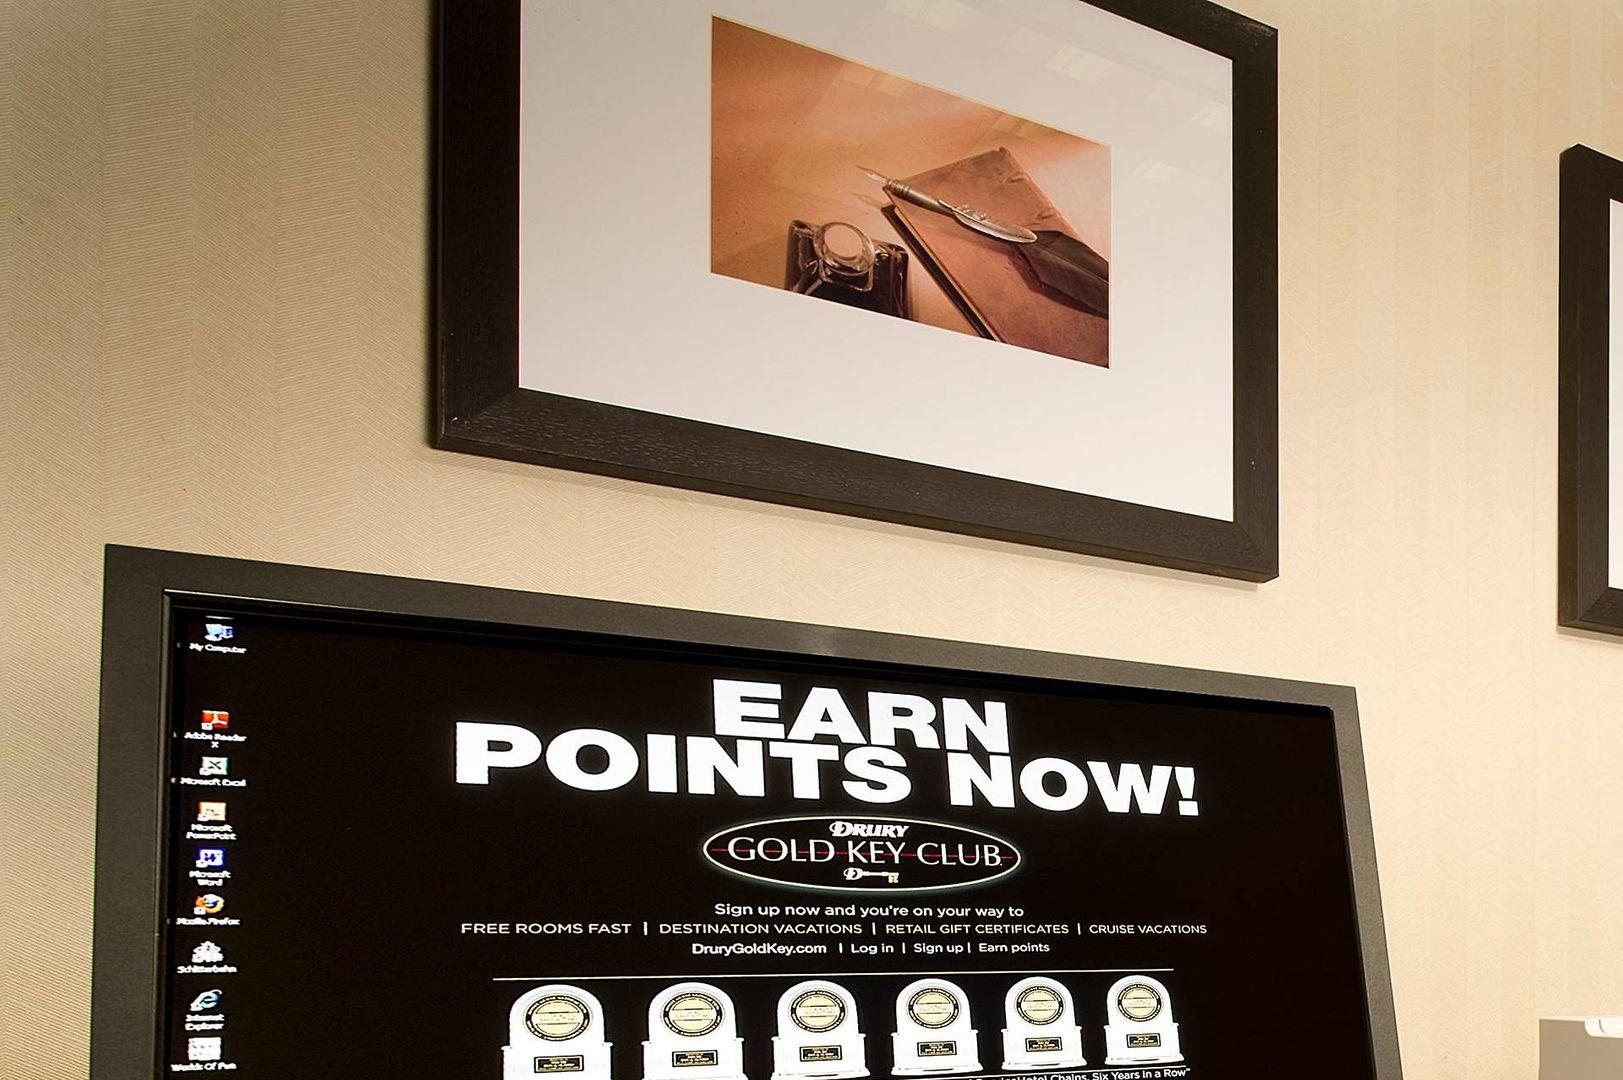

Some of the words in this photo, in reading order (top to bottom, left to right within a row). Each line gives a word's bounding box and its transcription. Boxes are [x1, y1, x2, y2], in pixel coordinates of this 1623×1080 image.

[712, 678, 1010, 755] EARN
[455, 721, 912, 804] POINTS
[946, 752, 1200, 817] NOW!
[727, 836, 835, 863] GOLD
[847, 840, 906, 864] KEY
[916, 842, 1002, 867] CLUB
[715, 903, 753, 918] Sign
[758, 906, 780, 917] up
[785, 906, 820, 916] now
[825, 904, 855, 916] and
[860, 905, 908, 918] you're
[913, 907, 932, 917] on
[937, 907, 971, 918] your
[975, 907, 1004, 918] way
[1008, 906, 1024, 916] to
[461, 923, 510, 934] FREE
[516, 923, 583, 935] ROOMS
[589, 923, 631, 934] FAST
[660, 923, 769, 934] DESTINATION
[774, 923, 862, 934] VACATIONS
[886, 924, 936, 934] RETAIL
[940, 924, 970, 934] GIFT
[975, 924, 1069, 934] CERTIFICATES
[1089, 924, 1134, 934] CRUISE
[1138, 924, 1207, 933] VACATIONS
[692, 942, 826, 956] DruryGoldKey.com
[851, 943, 877, 955] Log
[882, 943, 894, 953] in
[914, 943, 943, 955] Sign
[947, 945, 963, 954] up
[979, 943, 1008, 953] Earn
[1011, 943, 1050, 954] points
[1111, 1071, 1140, 1080] Years
[1143, 1070, 1152, 1079] in
[1155, 1070, 1161, 1078] a
